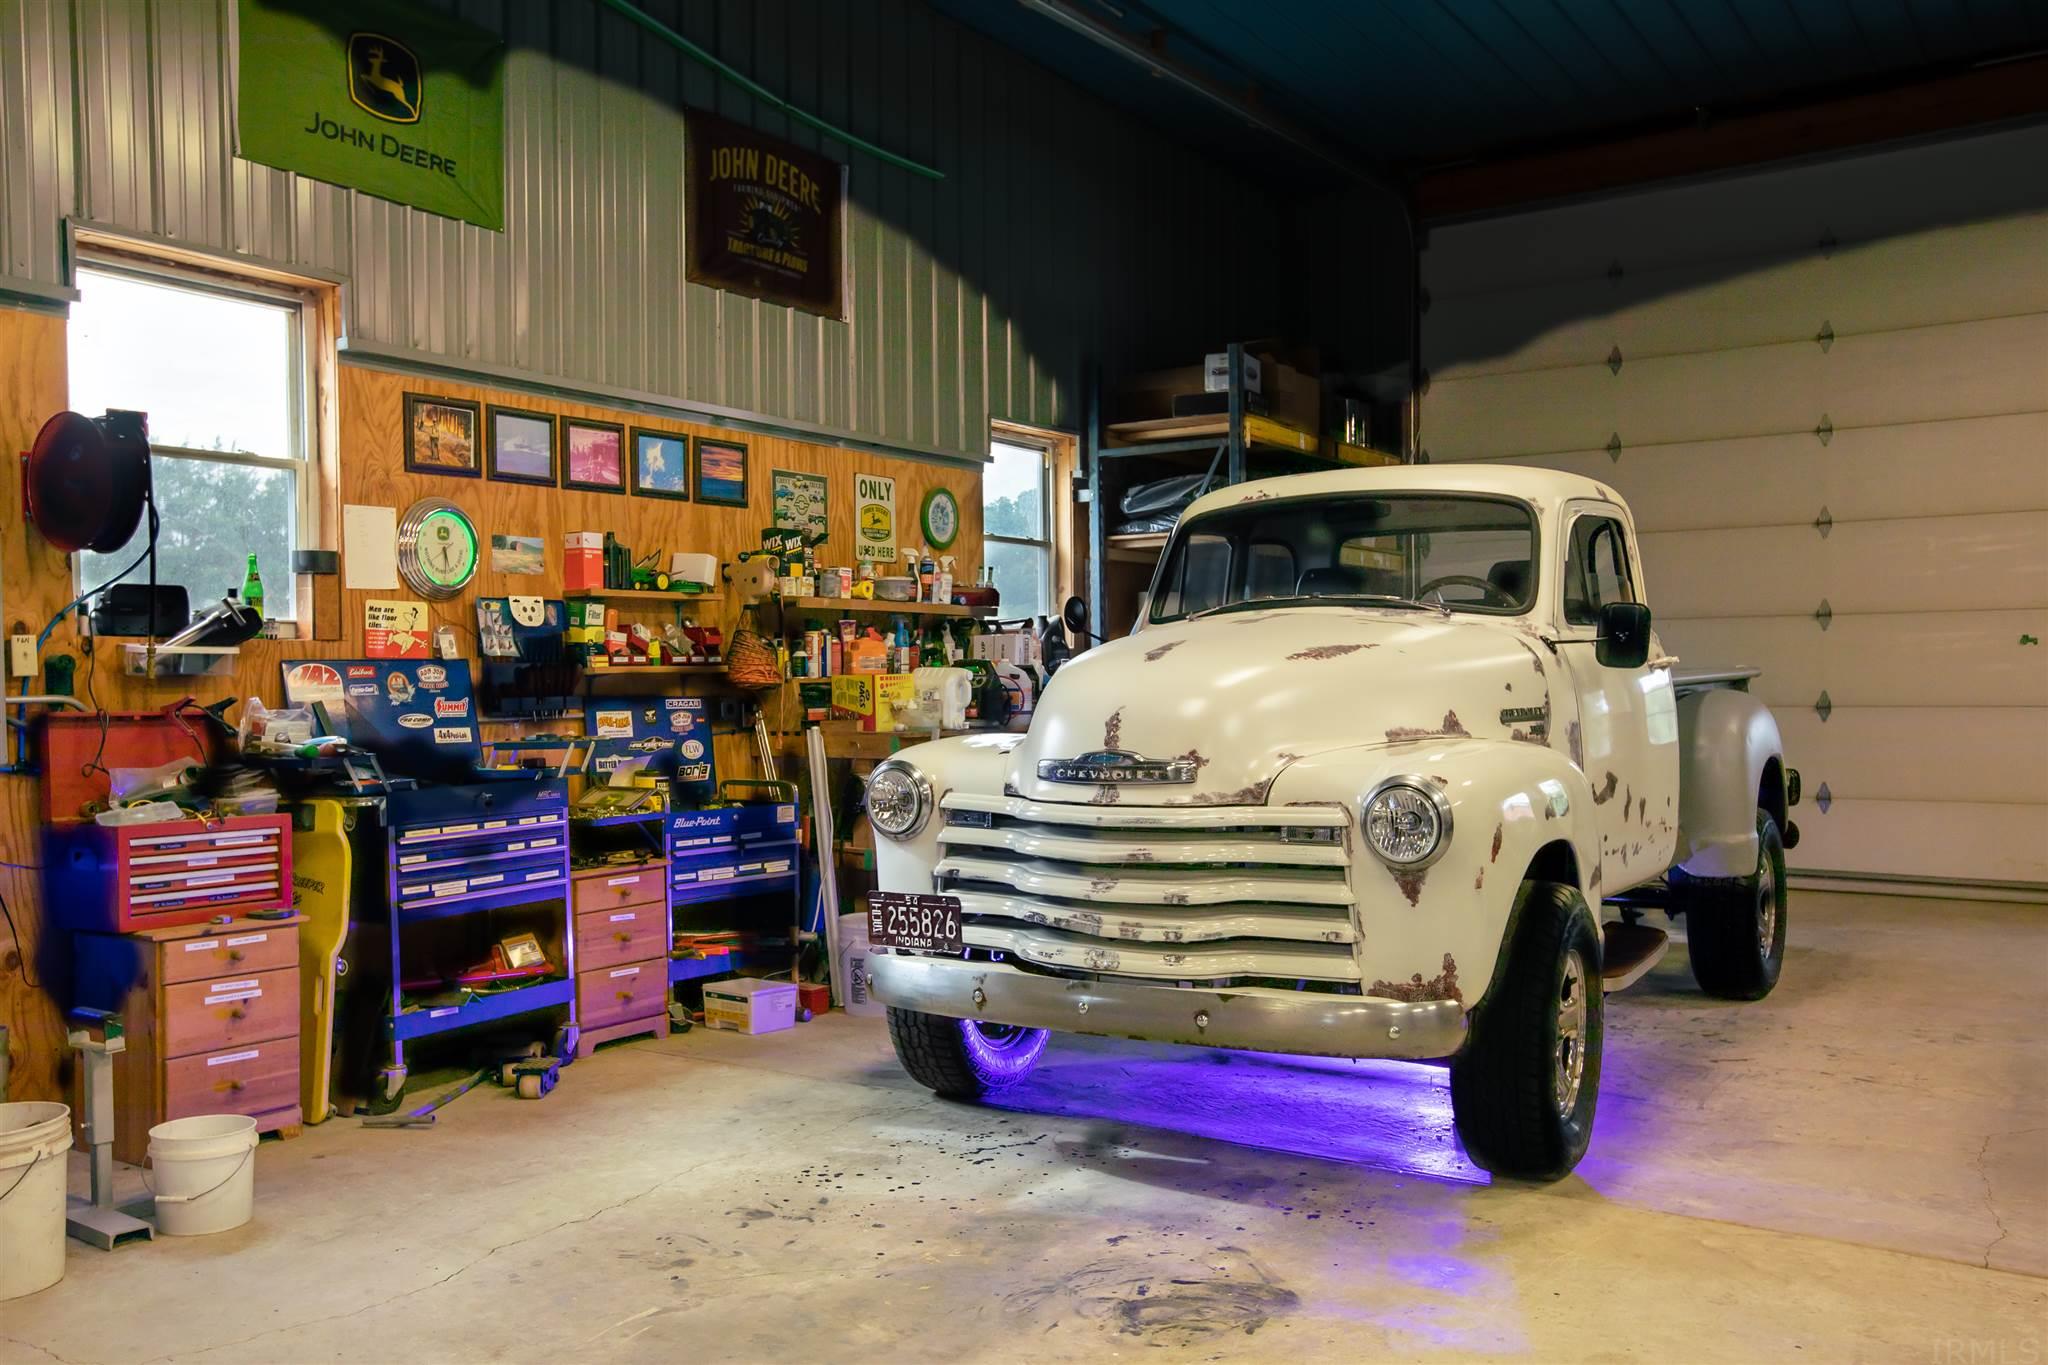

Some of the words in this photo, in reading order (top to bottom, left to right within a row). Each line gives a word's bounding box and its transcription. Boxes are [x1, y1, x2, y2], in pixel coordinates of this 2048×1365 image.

[304, 112, 375, 152] JOHN
[381, 133, 457, 178] DEERE
[709, 147, 759, 182] JOHN
[765, 153, 822, 216] DEERE
[859, 479, 892, 501] ONLY
[762, 534, 783, 550] WIX
[785, 535, 803, 551] WIX
[877, 546, 894, 558] HERE
[368, 605, 382, 613] Men
[587, 609, 602, 619] Filter
[368, 613, 380, 621] like
[381, 613, 398, 622] floor
[16, 636, 30, 645] FAN
[667, 700, 700, 708] CRAGAR
[1056, 767, 1164, 780] CHEVROLET
[673, 815, 721, 828] Blue-Point
[887, 905, 957, 939] 255826
[895, 936, 933, 948] INDIANA
